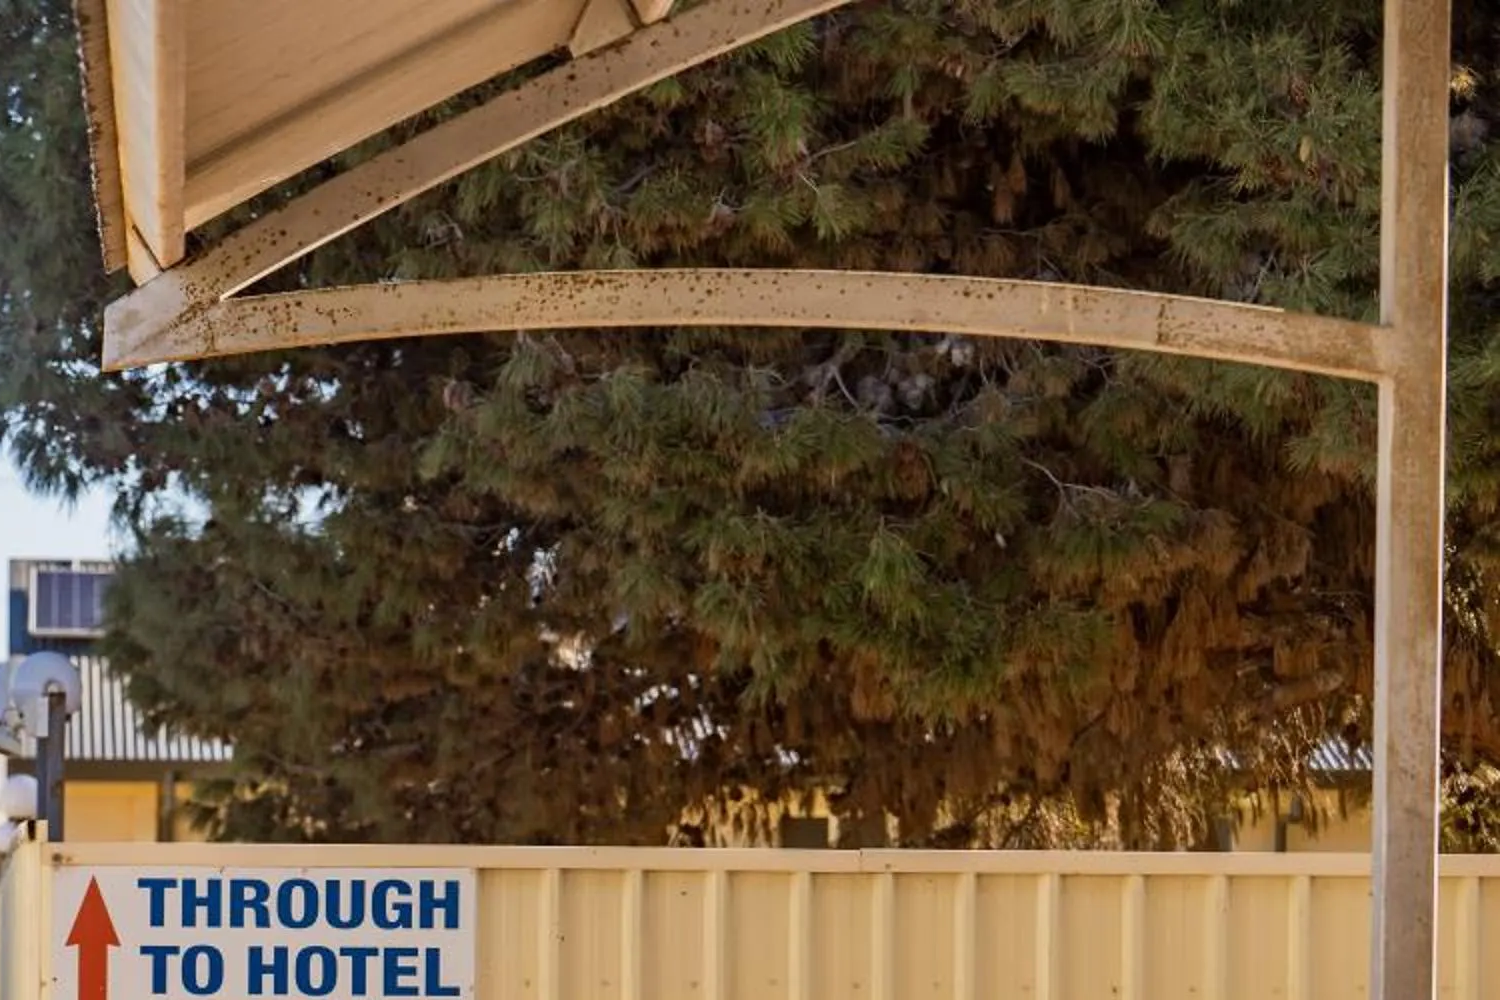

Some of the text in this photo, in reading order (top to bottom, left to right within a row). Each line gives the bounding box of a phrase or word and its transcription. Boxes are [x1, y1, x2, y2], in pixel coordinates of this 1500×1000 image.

[137, 877, 460, 930] THROUGH
[140, 944, 460, 997] TO HOTEL
